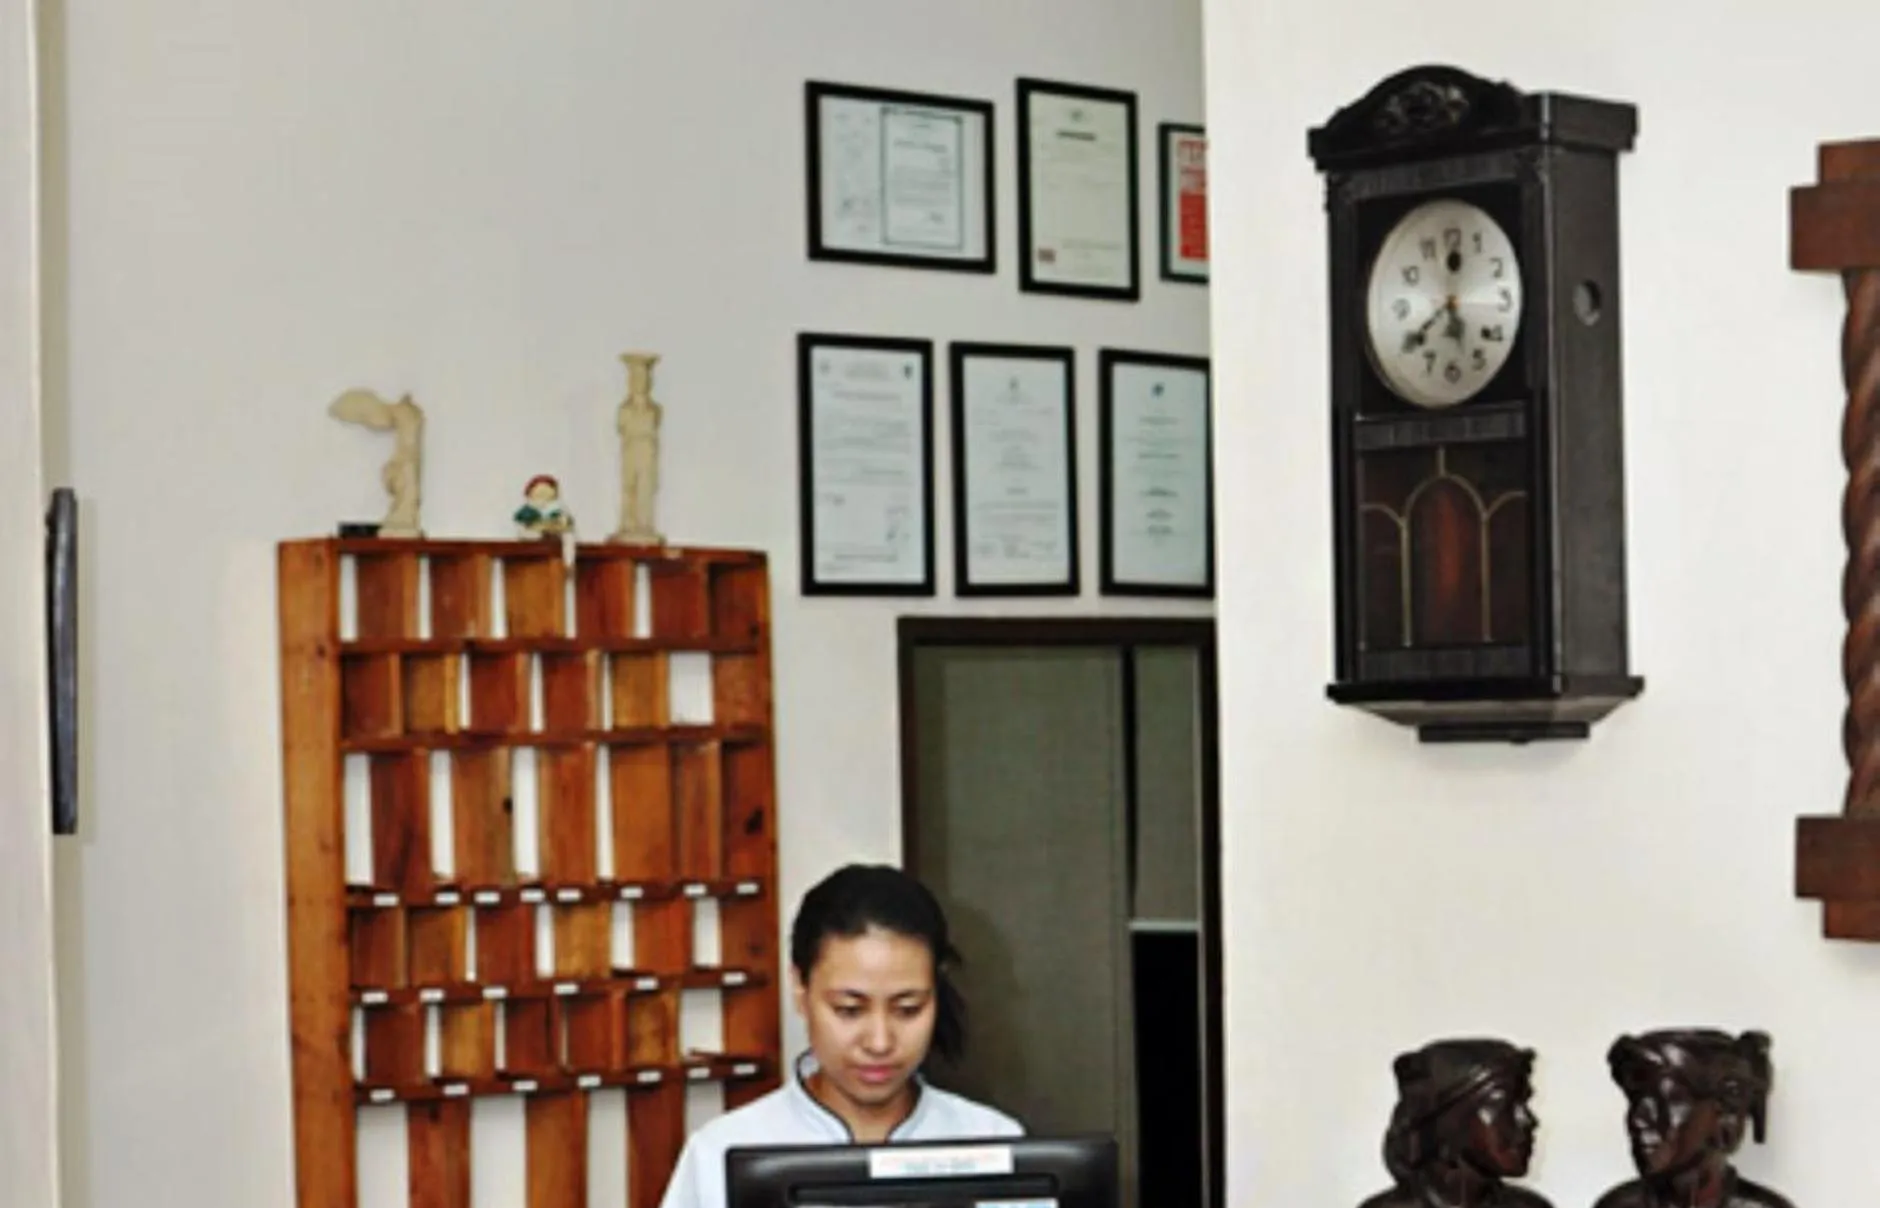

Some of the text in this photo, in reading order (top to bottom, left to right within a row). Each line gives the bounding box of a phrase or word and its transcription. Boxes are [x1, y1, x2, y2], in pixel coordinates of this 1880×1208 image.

[1489, 257, 1503, 279] 2
[1498, 288, 1513, 313] 3
[1422, 350, 1437, 375] 7
